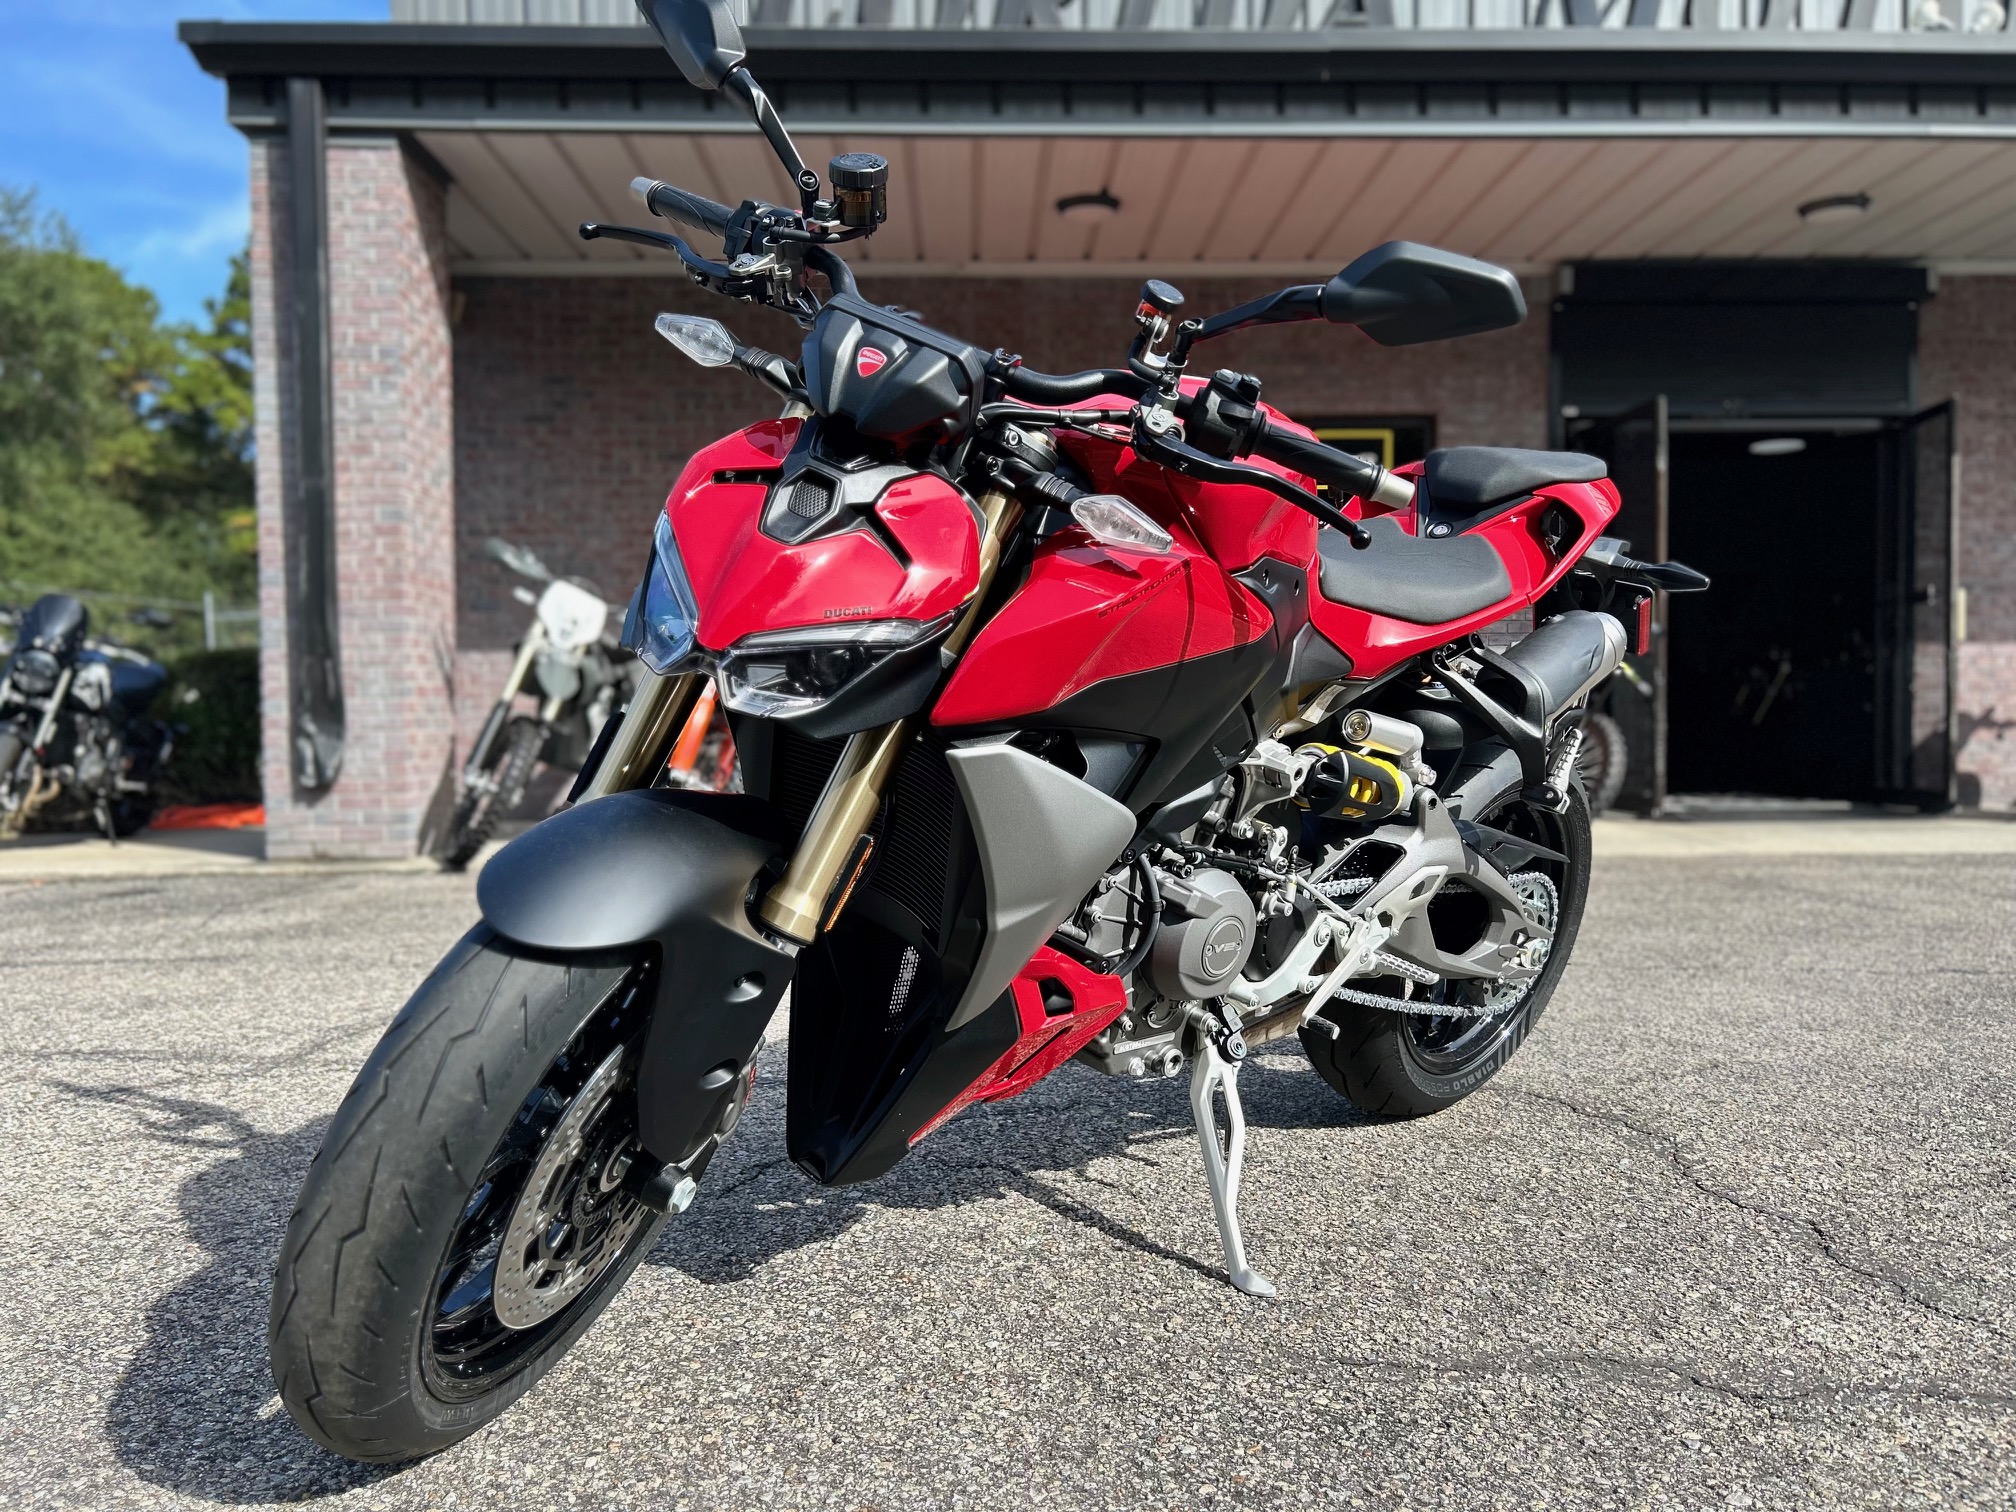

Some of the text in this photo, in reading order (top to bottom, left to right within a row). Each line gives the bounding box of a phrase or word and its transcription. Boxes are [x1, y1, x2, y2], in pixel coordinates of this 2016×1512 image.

[862, 349, 884, 362] DUCATI
[1097, 567, 1182, 618] STREETFIGHTER
[823, 606, 873, 619] DUCATI
[1214, 941, 1236, 954] V2
[1453, 1059, 1496, 1091] DIABLO
